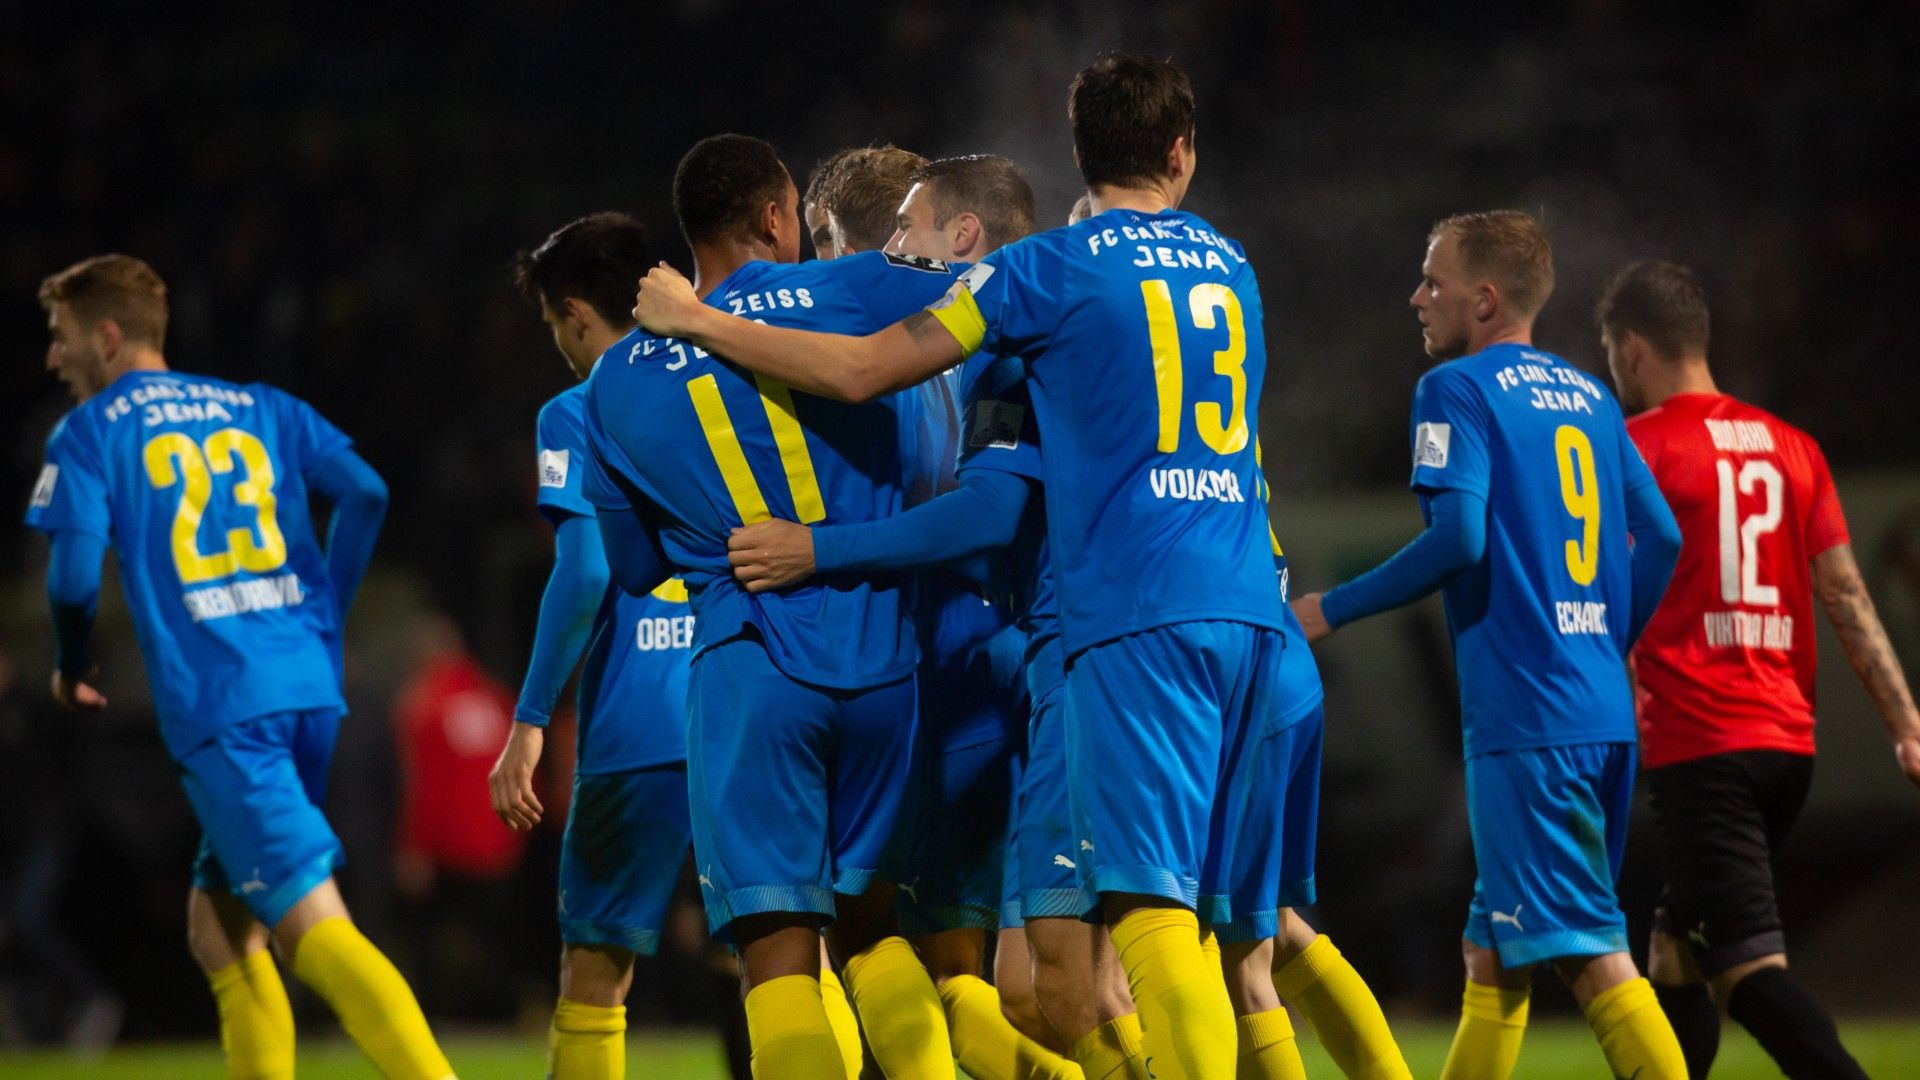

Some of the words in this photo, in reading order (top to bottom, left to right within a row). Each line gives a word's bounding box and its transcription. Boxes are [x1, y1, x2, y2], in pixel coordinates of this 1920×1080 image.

[1088, 229, 1119, 256] FC
[1133, 245, 1230, 275] JENA
[728, 287, 815, 317] ZEISS
[1140, 279, 1249, 456] 13
[1495, 366, 1519, 392] FC
[105, 395, 132, 423] FC
[143, 399, 233, 428] JENA
[1531, 387, 1593, 416] JENA
[687, 373, 826, 526] 11
[143, 428, 287, 584] 23
[1554, 424, 1601, 587] 9
[1716, 458, 1784, 606] 12
